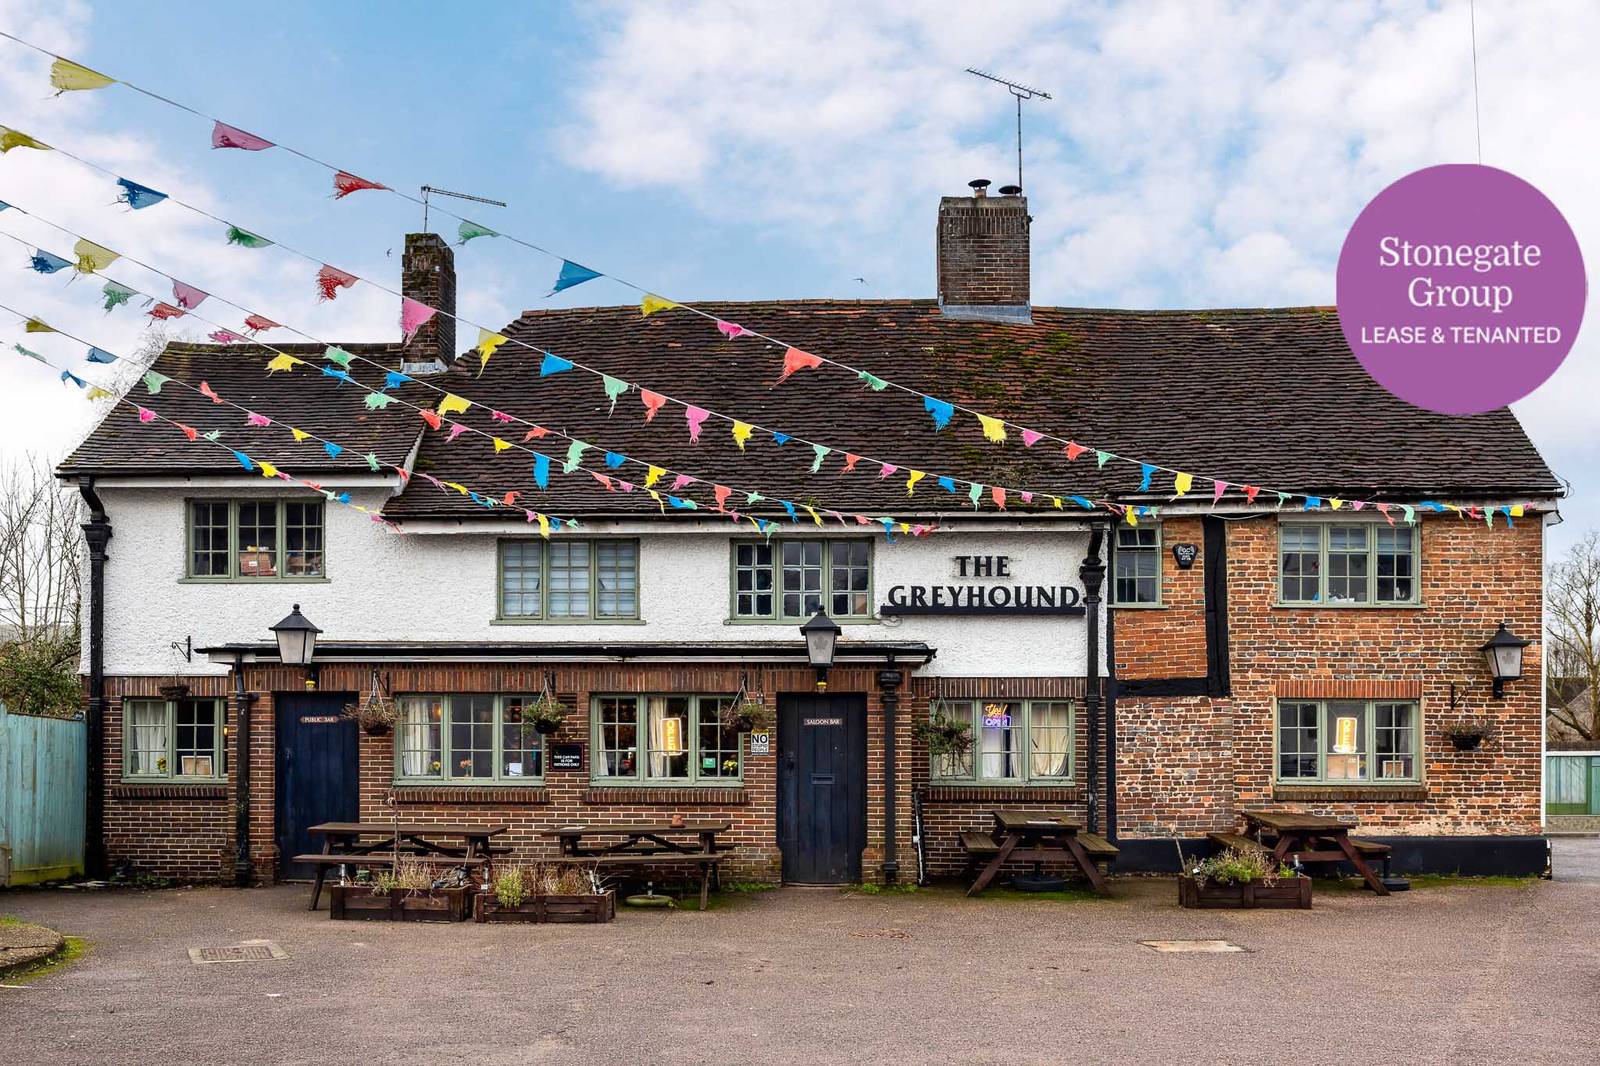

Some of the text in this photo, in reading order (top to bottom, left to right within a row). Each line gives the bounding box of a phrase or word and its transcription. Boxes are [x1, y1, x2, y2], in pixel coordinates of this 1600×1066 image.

[955, 555, 1011, 577] THE
[888, 585, 1081, 608] GREYHOUND
[985, 718, 1008, 726] OPEN
[752, 734, 768, 744] NO
